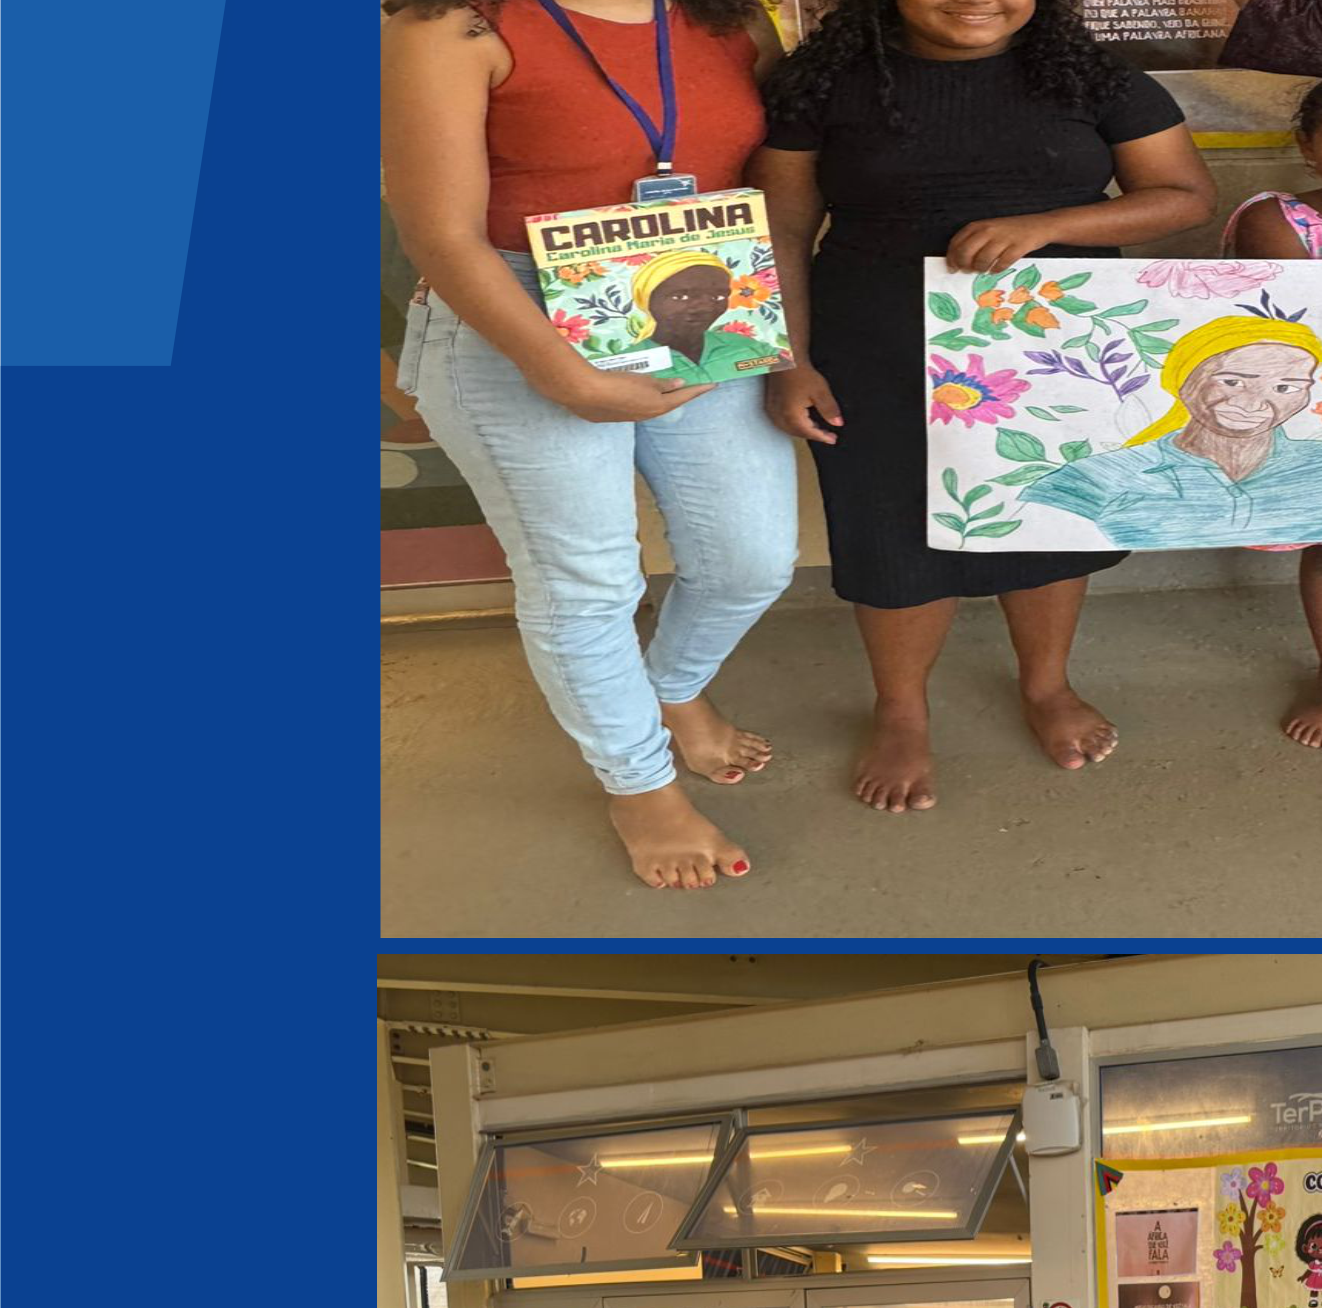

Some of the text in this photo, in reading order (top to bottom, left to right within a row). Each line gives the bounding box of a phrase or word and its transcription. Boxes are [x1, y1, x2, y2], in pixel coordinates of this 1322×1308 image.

[541, 202, 753, 251] CAROLINA
[546, 242, 623, 261] Carolina
[627, 235, 675, 250] Maria
[706, 226, 755, 240] Jesus
